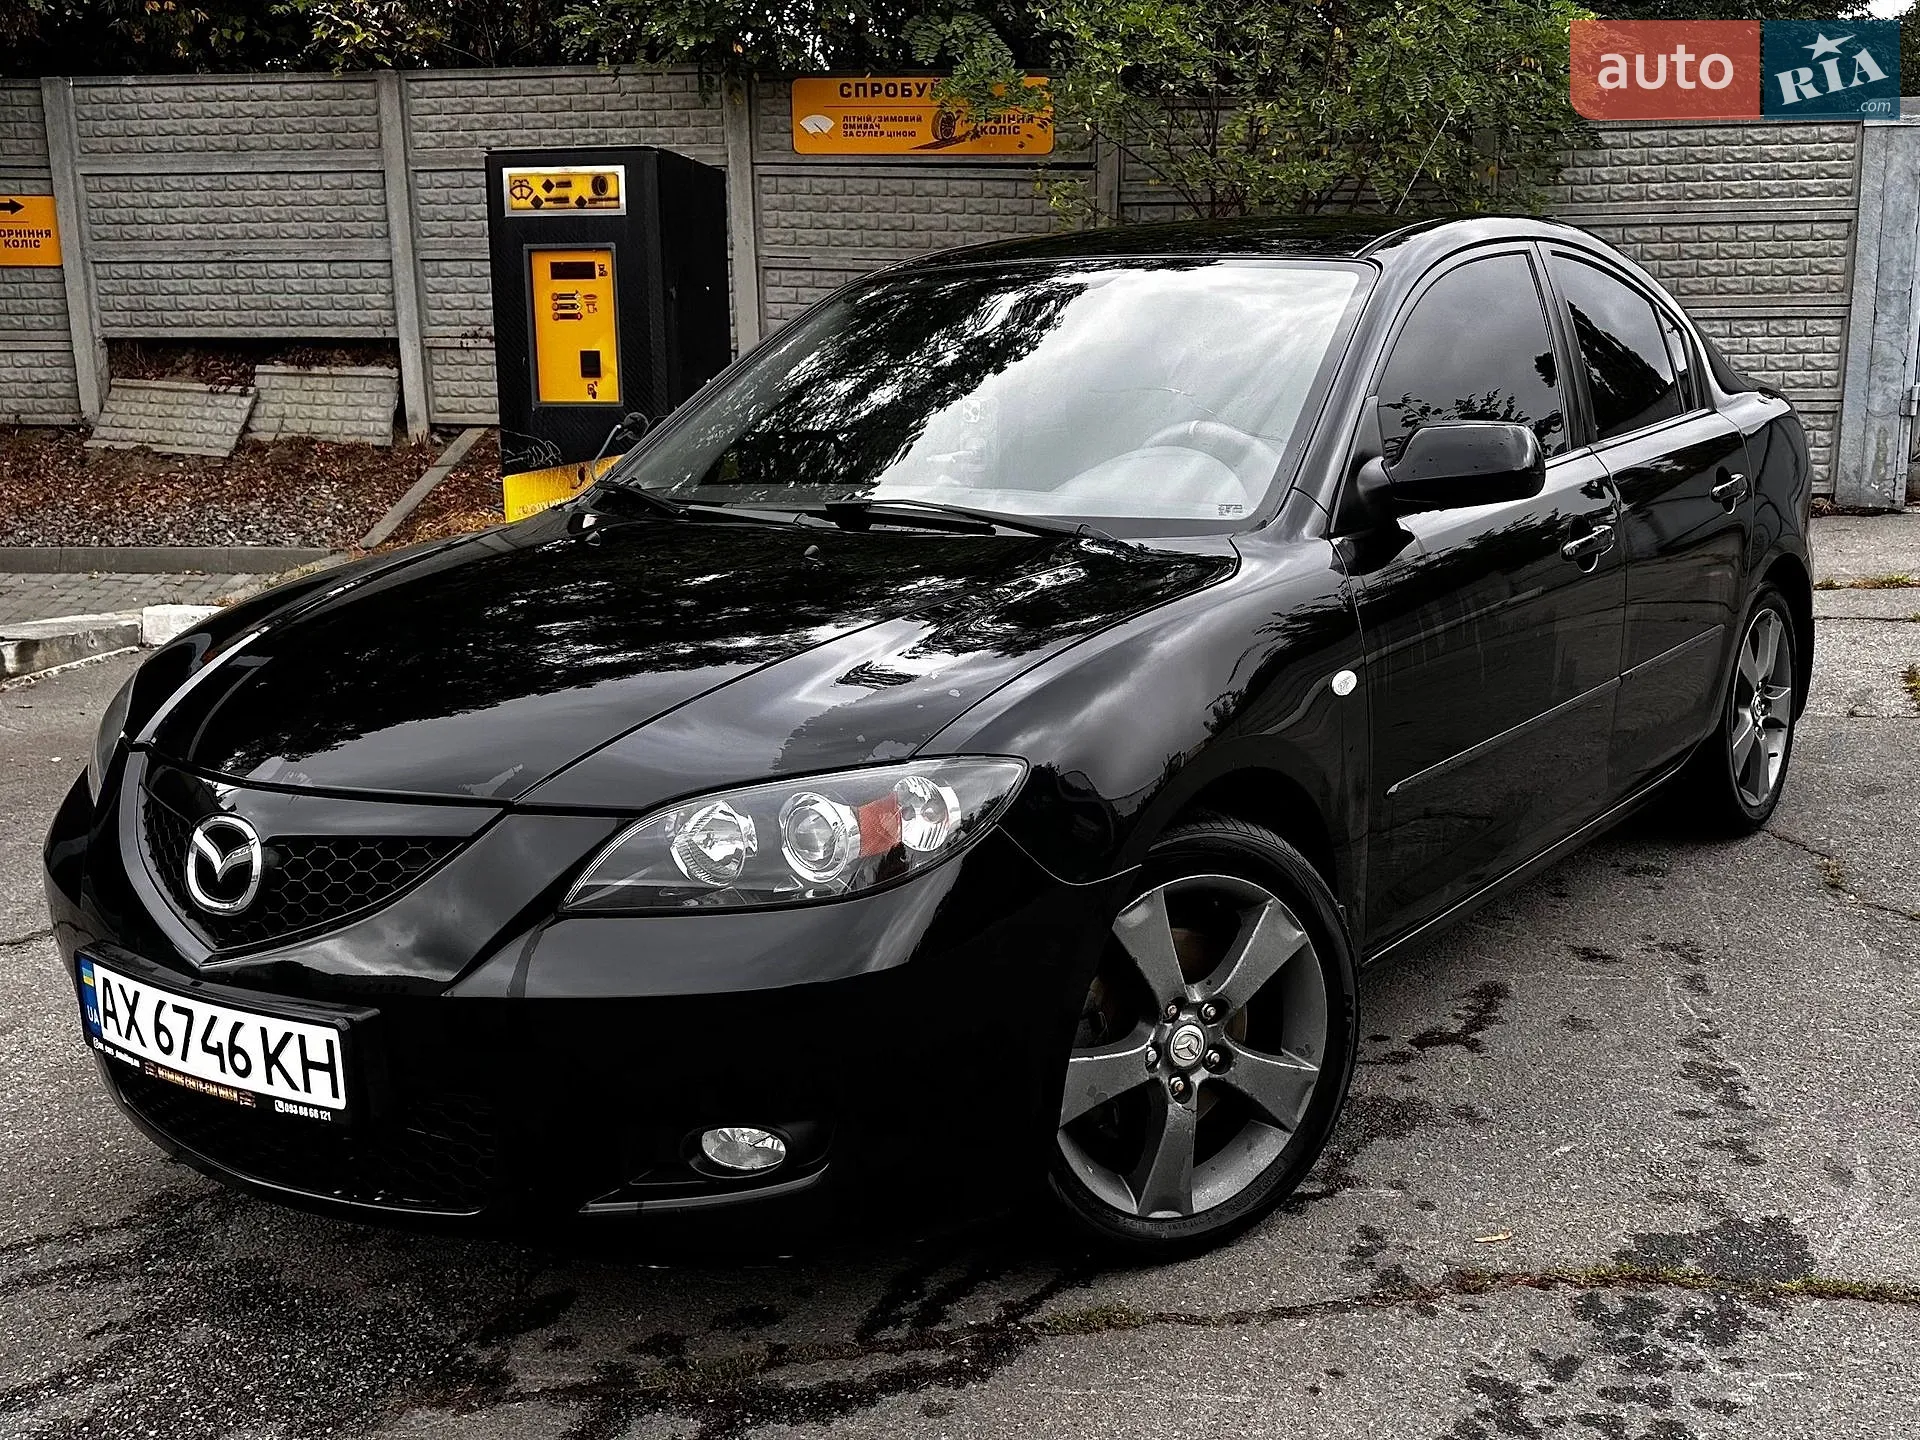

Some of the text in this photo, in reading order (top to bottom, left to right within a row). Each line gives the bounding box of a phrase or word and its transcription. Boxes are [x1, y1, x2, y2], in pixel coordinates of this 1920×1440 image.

[980, 125, 1021, 136] КОЛІС
[3, 238, 41, 249] КОЛІС
[86, 1003, 100, 1027] UA
[102, 976, 147, 1049] AX
[153, 999, 253, 1079] 6746
[259, 1026, 340, 1100] KH
